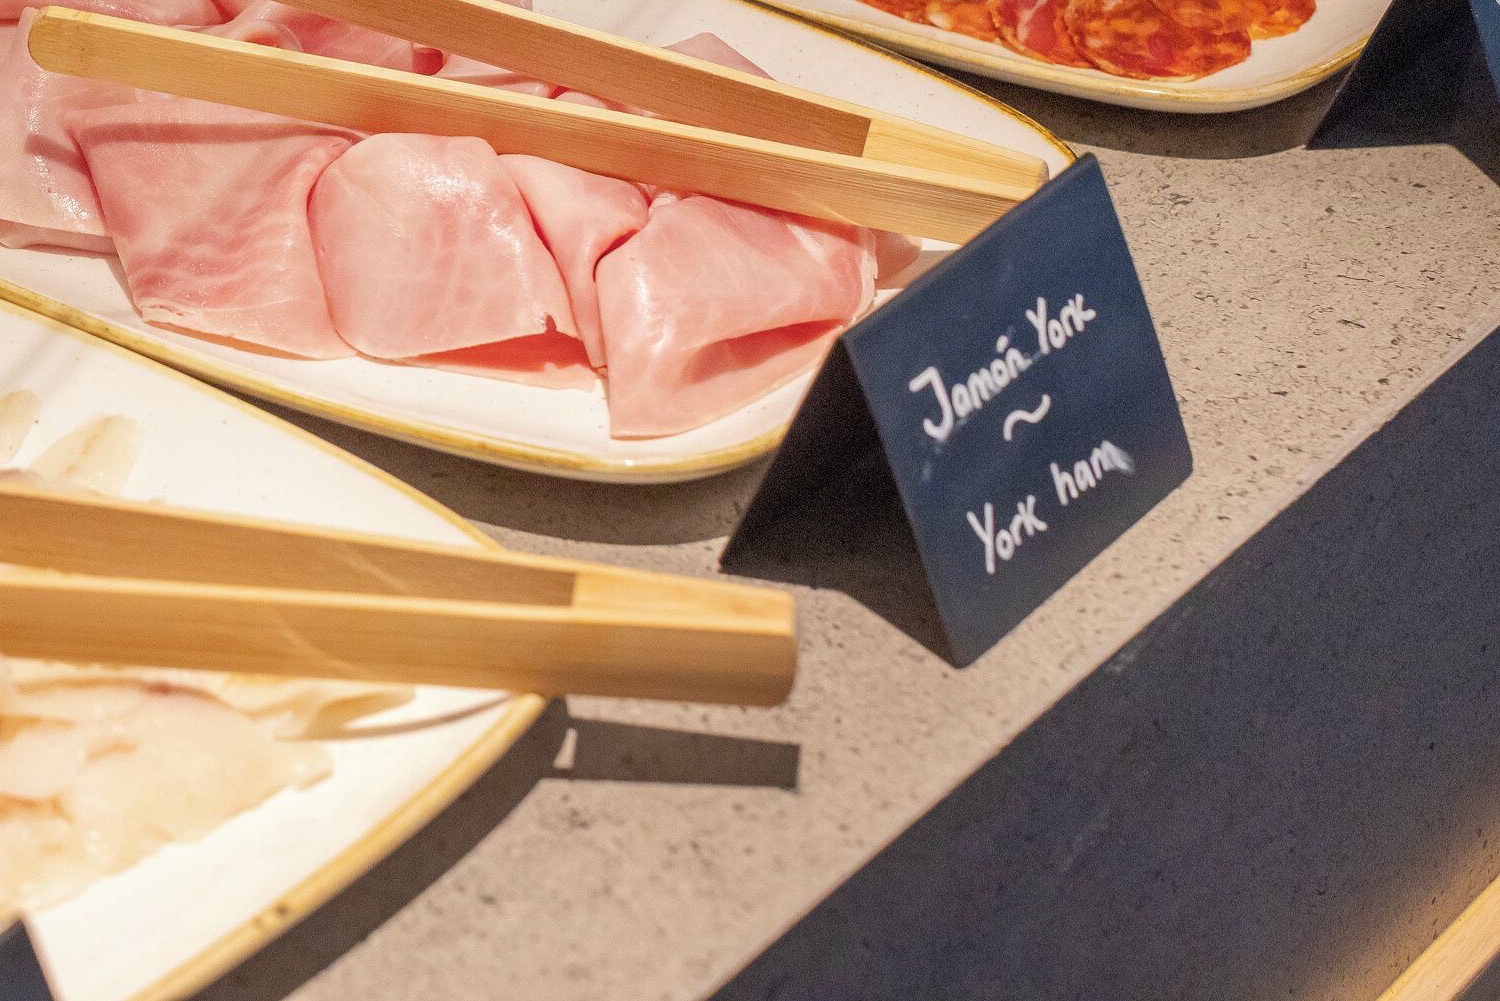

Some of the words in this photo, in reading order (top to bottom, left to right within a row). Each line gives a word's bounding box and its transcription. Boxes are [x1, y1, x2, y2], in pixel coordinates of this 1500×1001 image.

[1025, 293, 1097, 355] York
[966, 494, 1049, 575] York
[1050, 439, 1136, 506] ham
